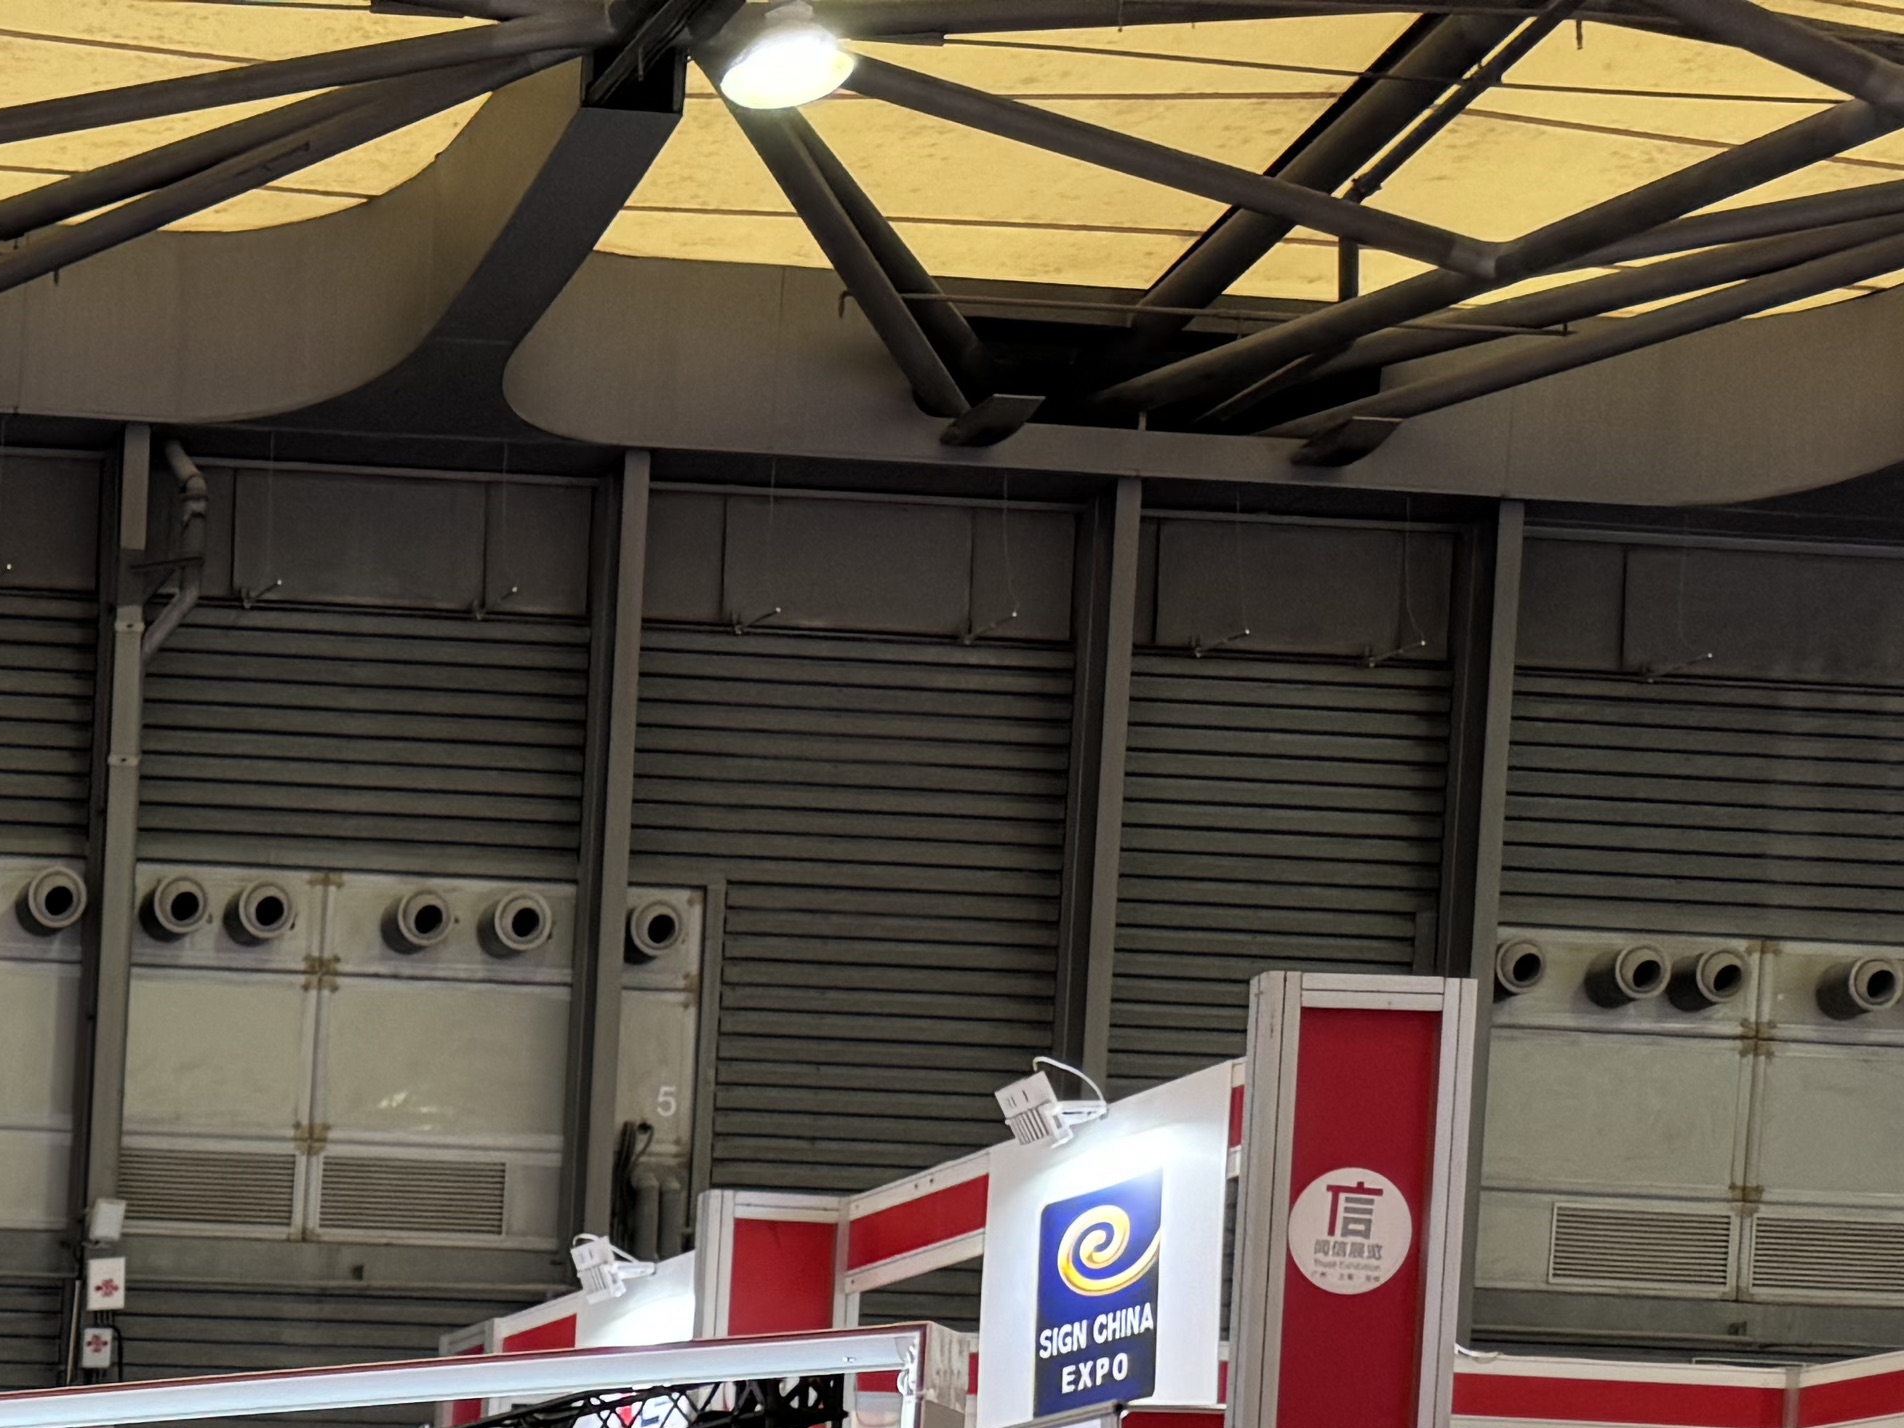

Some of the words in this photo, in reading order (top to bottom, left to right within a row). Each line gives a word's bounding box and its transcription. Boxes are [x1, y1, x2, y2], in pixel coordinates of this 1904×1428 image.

[656, 1085, 677, 1118] 5
[1039, 1312, 1088, 1361] SIGN
[1093, 1303, 1155, 1344] CHINA
[1062, 1353, 1130, 1396] EXPO
